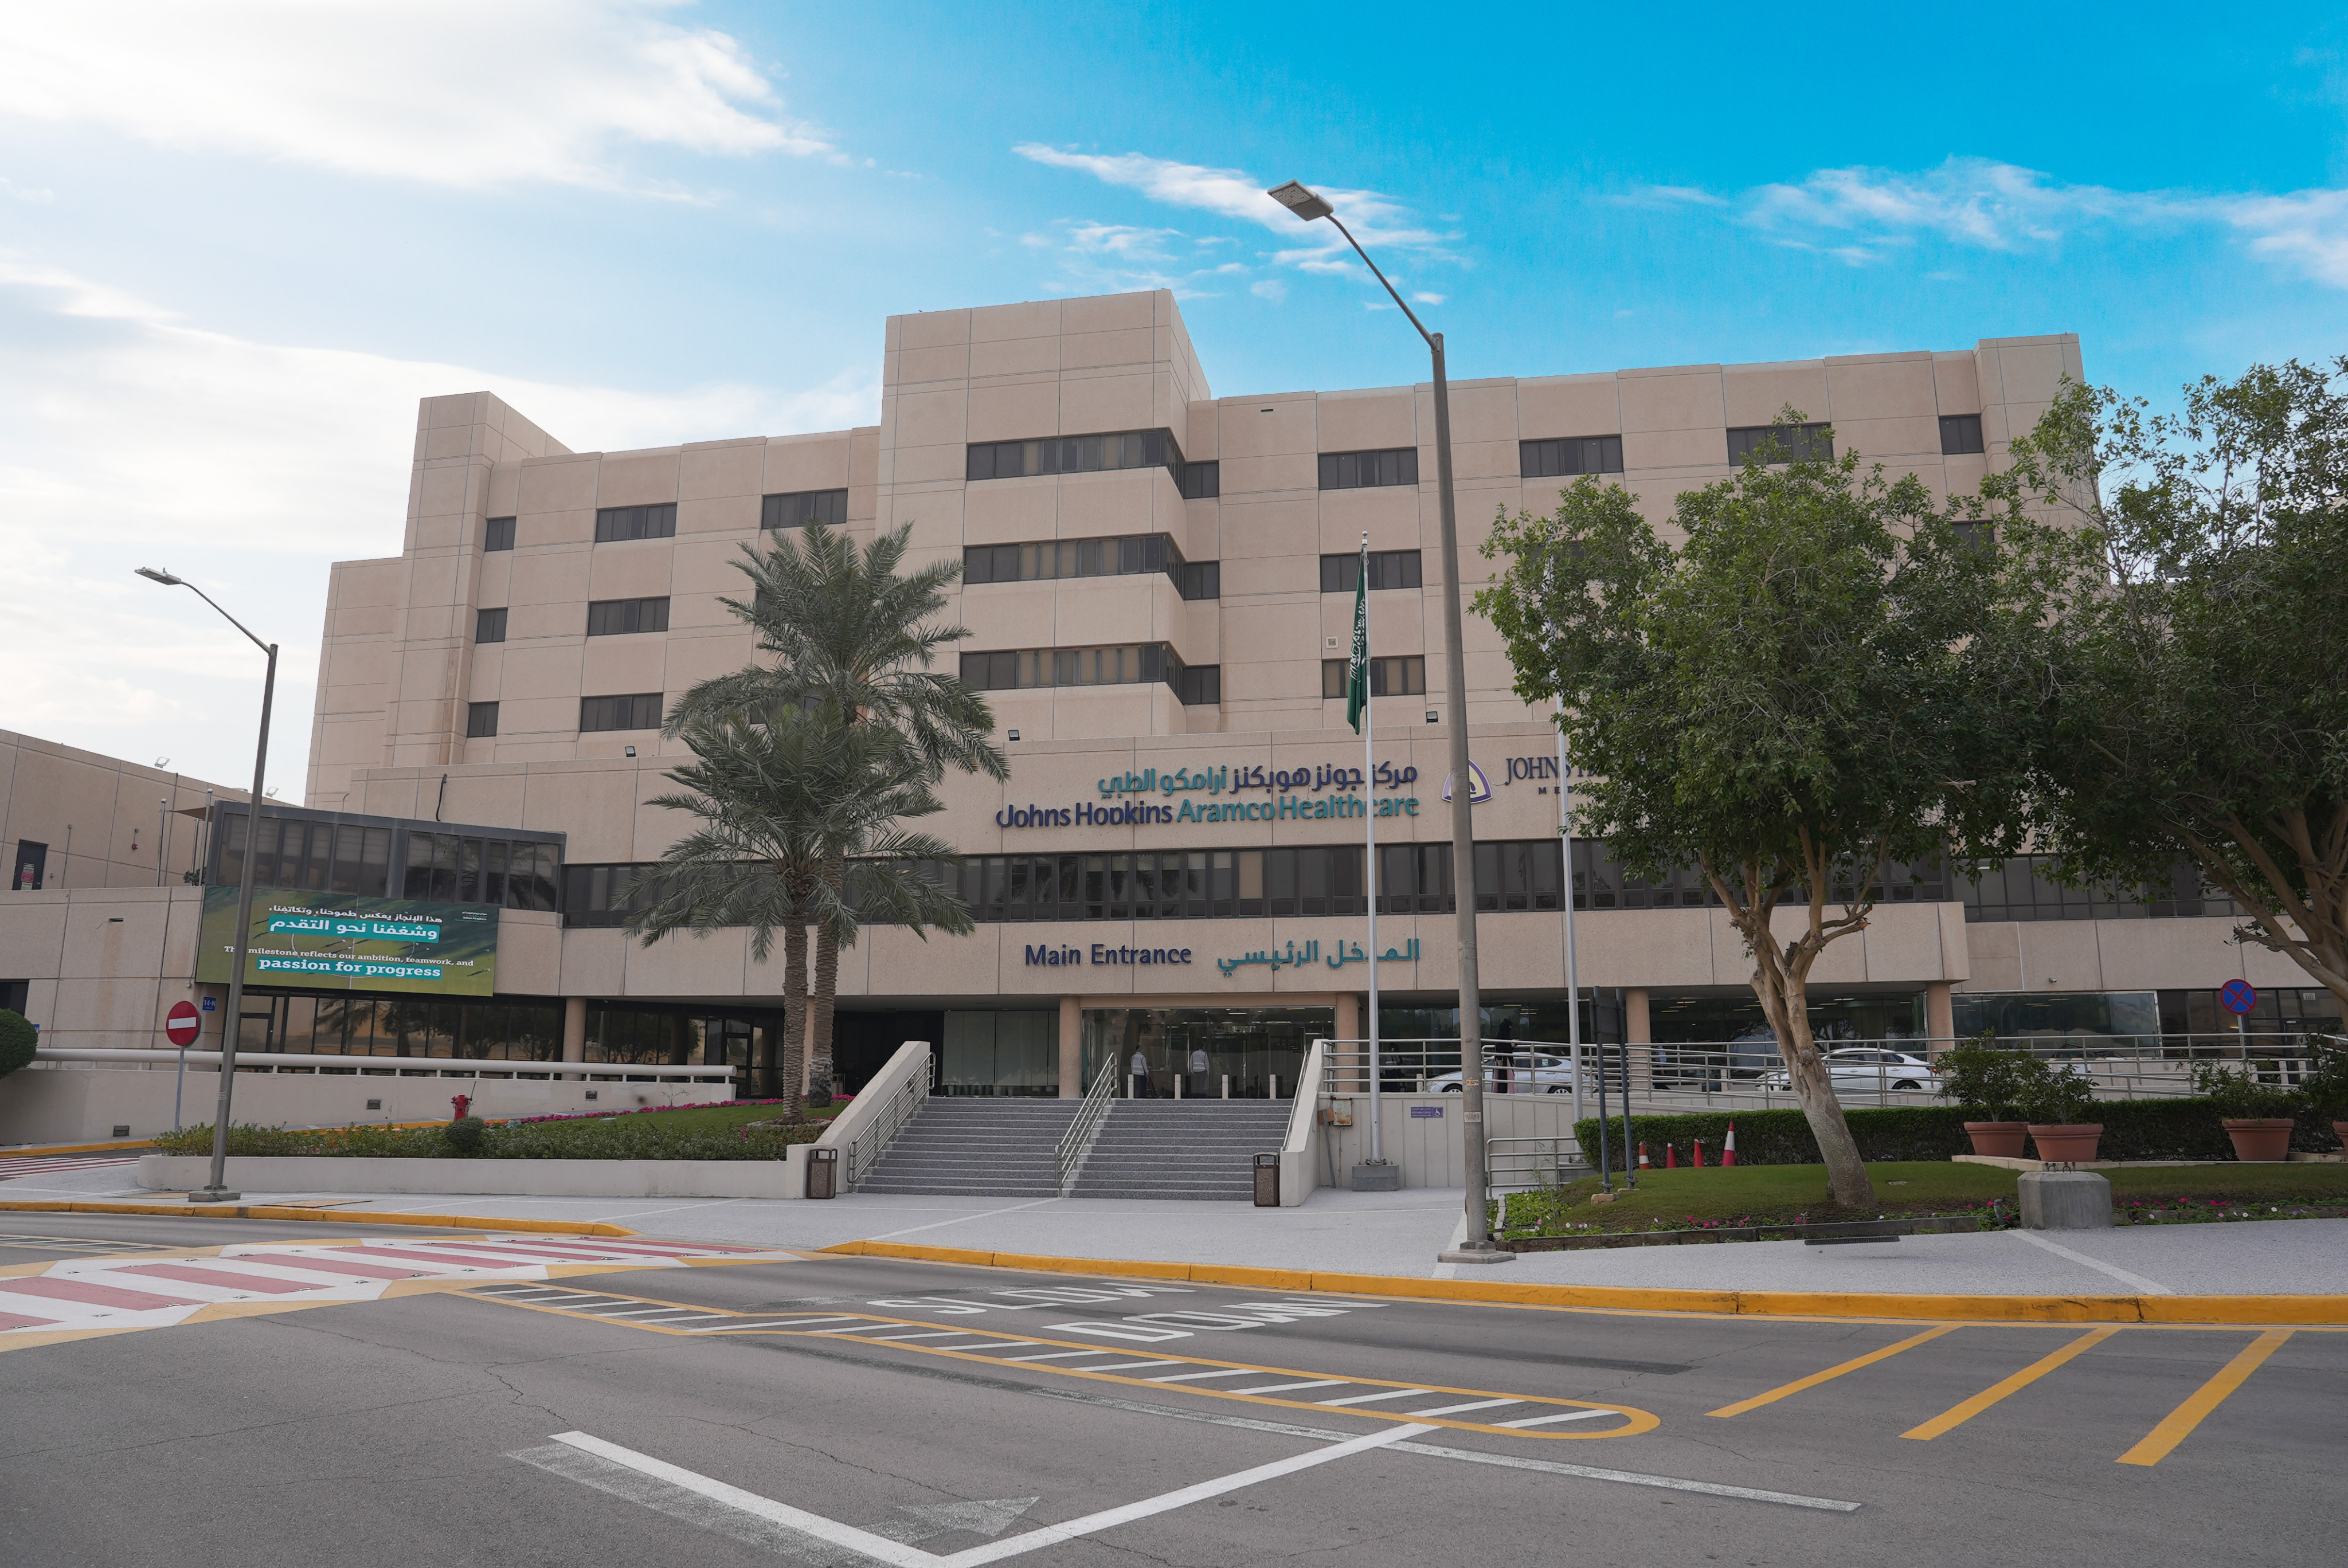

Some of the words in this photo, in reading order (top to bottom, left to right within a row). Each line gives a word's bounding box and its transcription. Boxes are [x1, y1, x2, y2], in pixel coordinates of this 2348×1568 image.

[1098, 768, 1156, 799] الطبي
[1160, 765, 1227, 796] أرامكو
[1229, 766, 1311, 794] هوبكنز
[1312, 763, 1365, 791] جونز
[1365, 761, 1418, 789] مركز
[996, 804, 1071, 827] Johns
[1075, 801, 1173, 825] Hopkins
[1177, 799, 1275, 822] Aramco
[1279, 793, 1420, 820] Healthcare
[270, 919, 330, 932] التقدم
[336, 923, 366, 934] نحو
[359, 912, 392, 921] يعكس
[394, 913, 422, 923] الإنجاز
[425, 915, 443, 923] هذا
[373, 923, 437, 940] وشغفنا
[248, 948, 298, 956] milestone
[300, 950, 337, 959] reflects
[358, 954, 404, 963] ambition,
[406, 957, 455, 966] teamwork,
[1026, 944, 1081, 965] Main
[1091, 943, 1192, 965] Entrance
[1218, 940, 1318, 977] الرئيسي
[1327, 938, 1420, 969] المخل
[259, 959, 331, 970] passion
[335, 961, 362, 972] for
[366, 965, 441, 977] progress
[866, 1282, 1199, 1314] SLOW
[1040, 1297, 1391, 1342] DOWN
